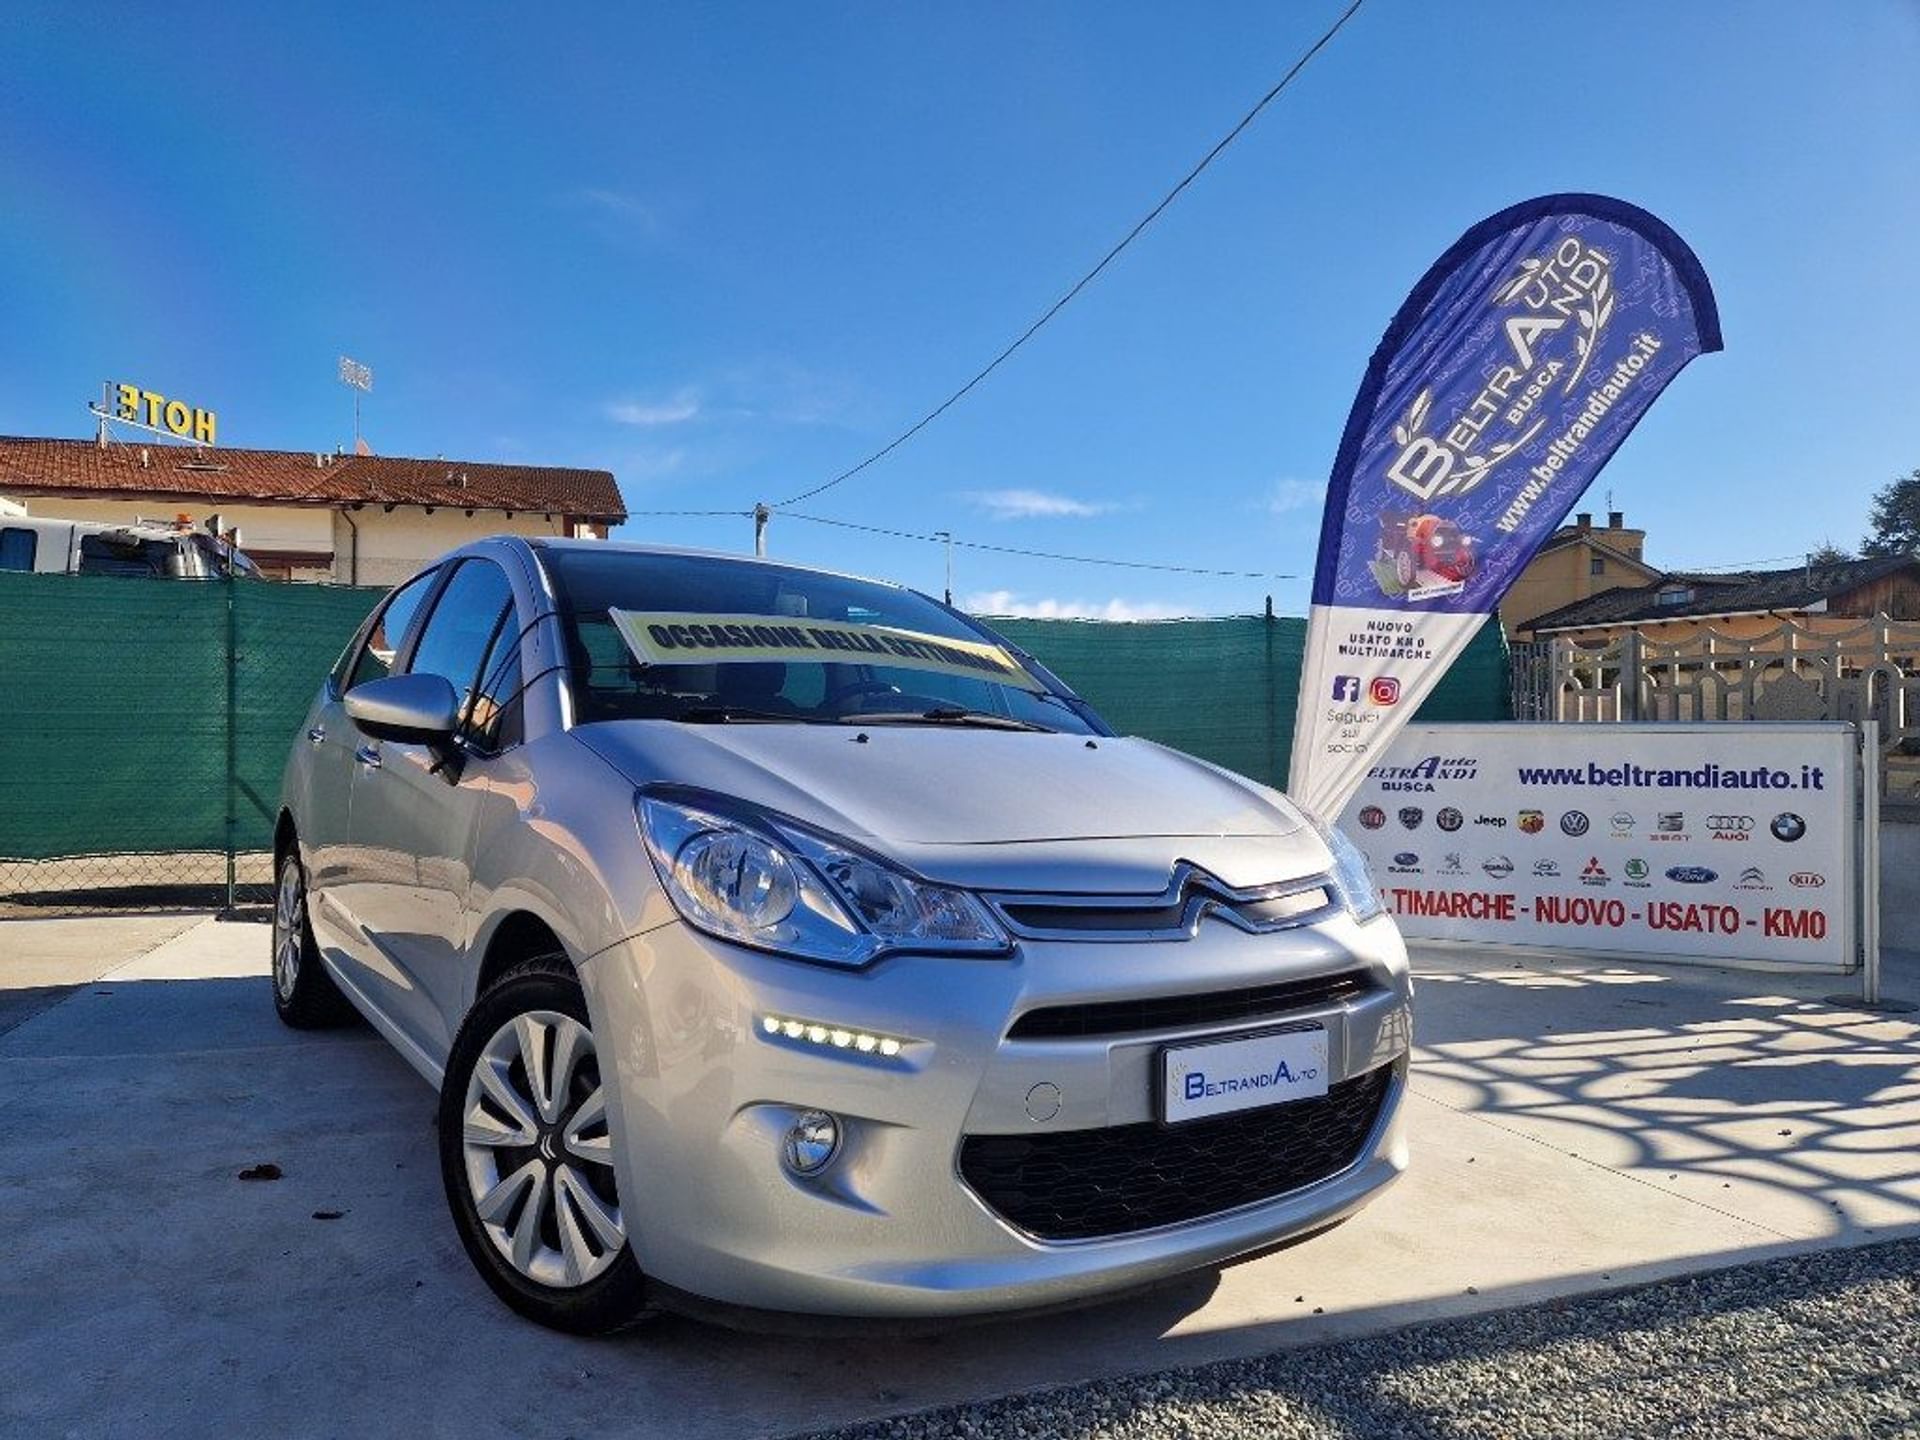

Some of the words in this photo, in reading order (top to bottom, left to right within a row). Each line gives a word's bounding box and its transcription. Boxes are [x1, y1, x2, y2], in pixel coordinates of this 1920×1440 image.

[1505, 359, 1564, 425] BUSCA
[1497, 333, 1661, 533] www.beltrandiauto.it
[1367, 621, 1413, 633] NUOVO
[647, 624, 815, 649] OCCASIONE
[806, 628, 891, 653] DELLA
[1350, 634, 1392, 645] USATO
[1338, 645, 1432, 659] MULTIMARCHE
[1327, 709, 1379, 724] Seguici
[1519, 762, 1824, 790] www.beltrandiauto.it
[1381, 781, 1436, 793] BUSCA
[1474, 814, 1508, 828] Jeep
[1675, 868, 1708, 883] Ford
[1793, 874, 1821, 886] KIA
[1536, 896, 1625, 928] NUOVO
[1648, 902, 1740, 935] USATO
